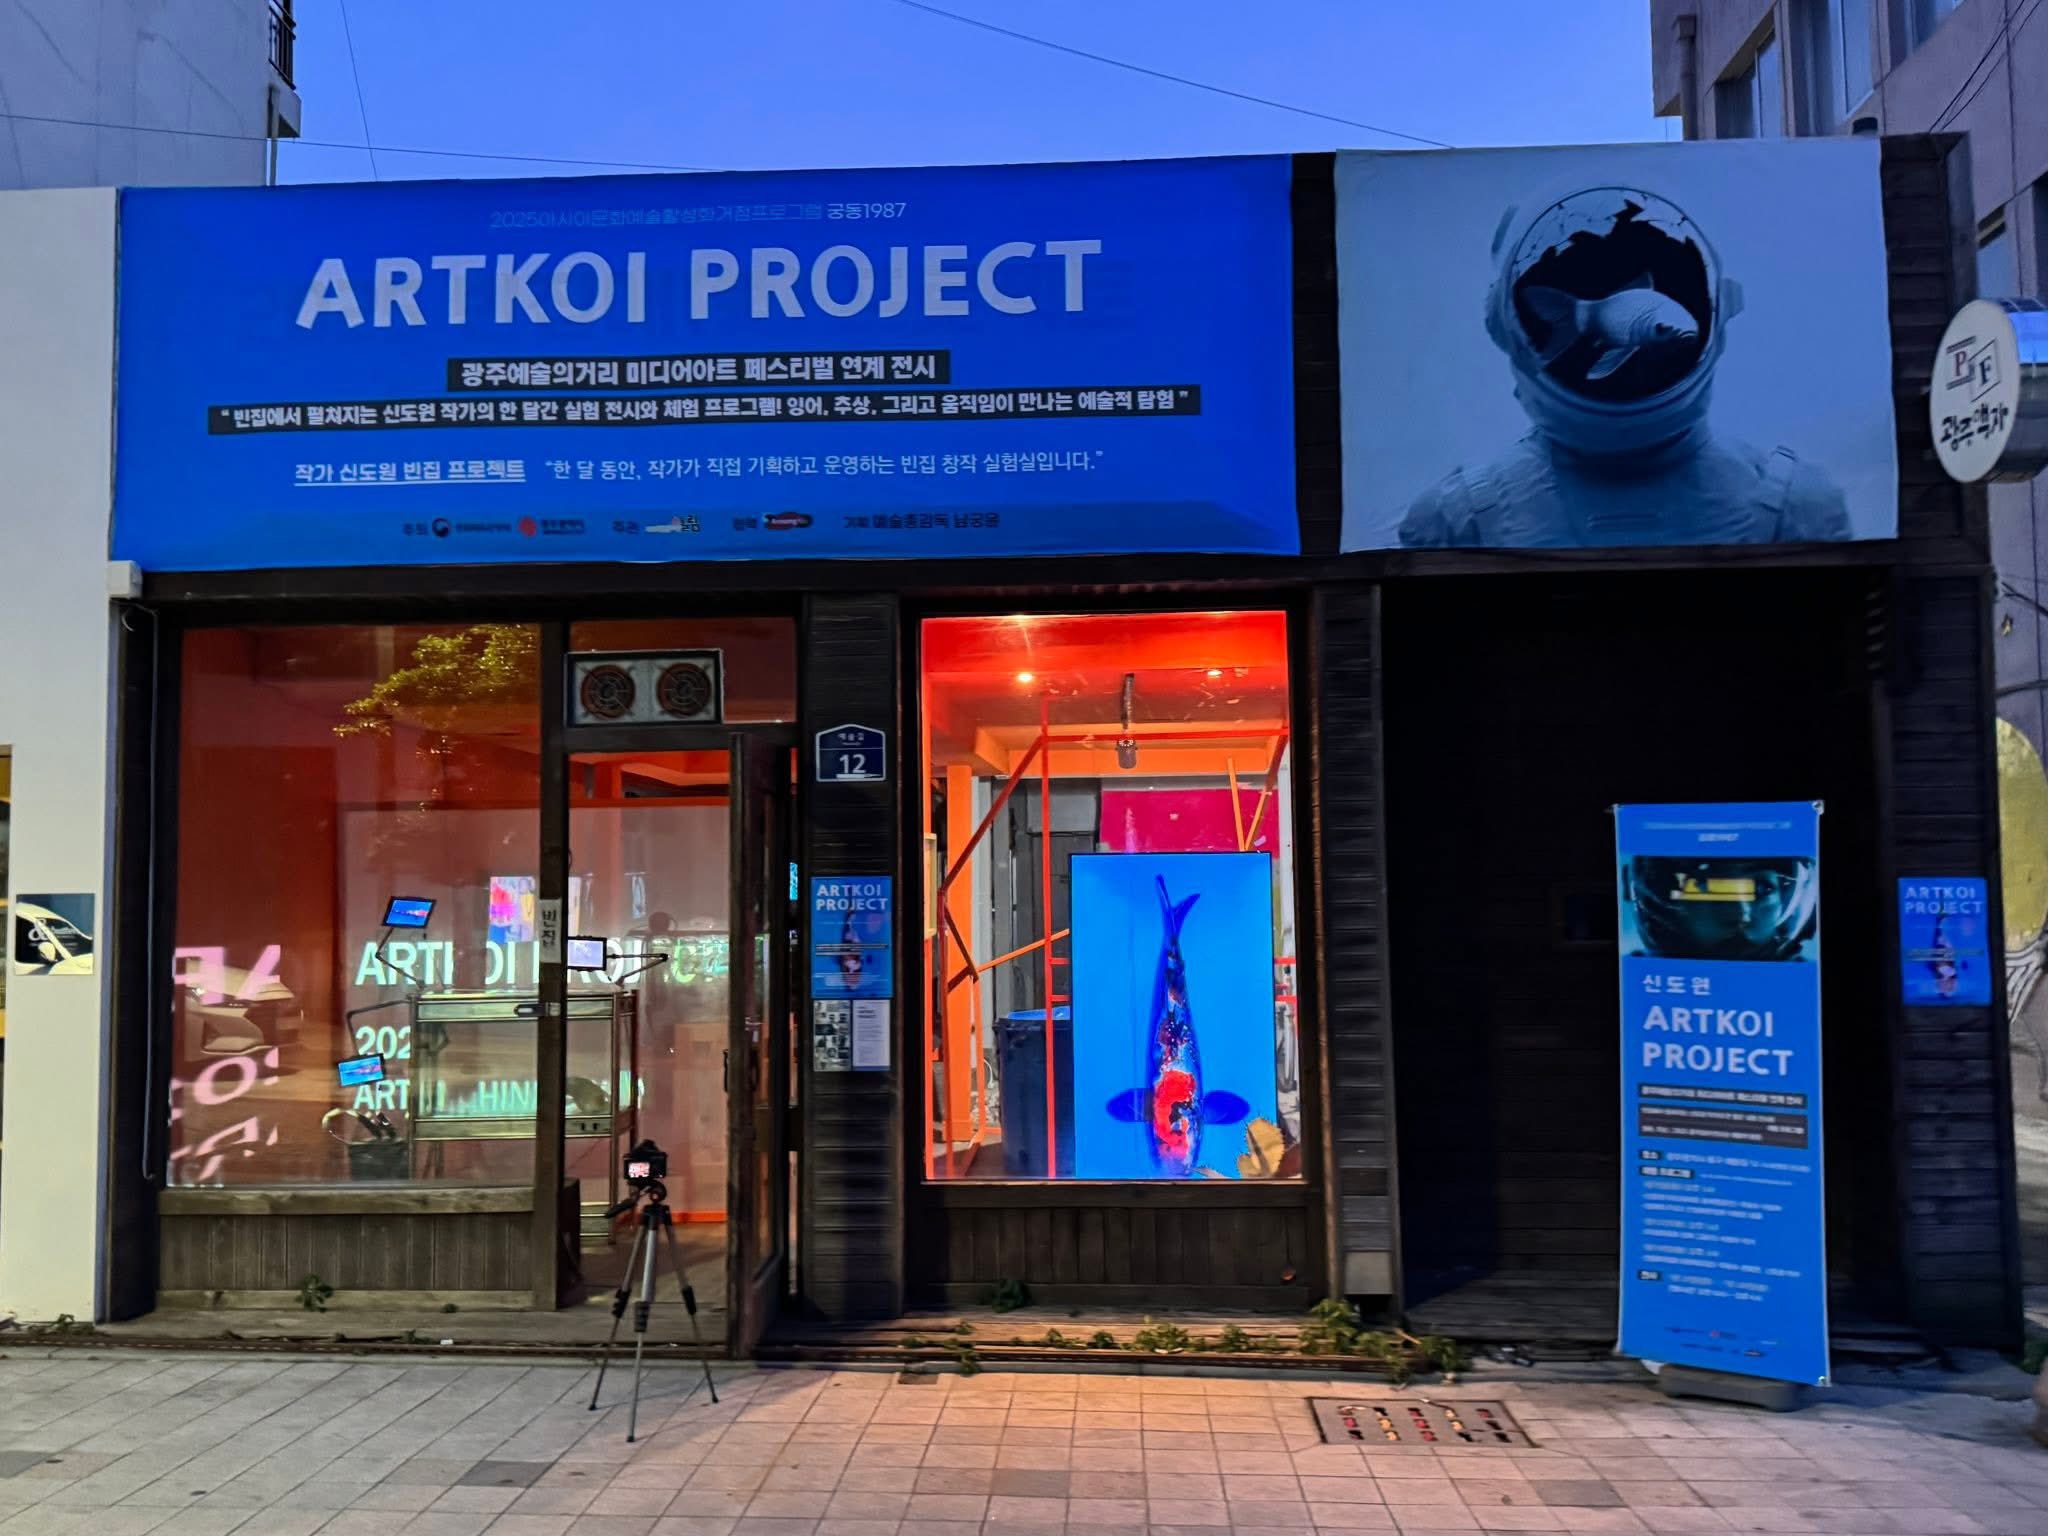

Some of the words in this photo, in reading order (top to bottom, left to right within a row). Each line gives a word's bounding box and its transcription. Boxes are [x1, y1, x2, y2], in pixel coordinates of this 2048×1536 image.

[827, 202, 907, 220] 궁동1987
[295, 251, 646, 330] ARTKOI
[690, 239, 1102, 320] PROJECT
[461, 361, 619, 387] 광주예술의거리
[626, 358, 738, 385] 미디어아트
[743, 356, 834, 382] 페스티벌
[840, 355, 885, 380] 연계
[891, 354, 936, 380] 전시
[382, 402, 436, 424] 신도원
[440, 401, 495, 422] 작가의
[498, 401, 518, 422] 한
[522, 401, 559, 421] 달간
[564, 400, 600, 421] 실험
[604, 399, 659, 421] 전시와
[663, 398, 700, 419] 체험
[786, 396, 829, 417] 잉어,
[833, 395, 877, 416] 추상,
[881, 395, 937, 415] 그리고
[940, 393, 1014, 415] 움직임이
[1018, 391, 1074, 412] 만나는
[1077, 390, 1132, 411] 예술적
[1137, 389, 1175, 410] 탐험
[295, 463, 335, 485] 작가
[339, 462, 397, 483] 신도원
[403, 461, 444, 483] 빈집
[447, 459, 526, 481] 프로젝트
[577, 460, 595, 480] 달
[599, 460, 641, 481] 동안,
[647, 458, 701, 479] 작가가
[707, 457, 741, 477] 직접
[748, 456, 819, 476] 기획하고
[823, 455, 896, 476] 운영하는
[901, 455, 936, 475] 빈집
[941, 454, 978, 475] 창작
[837, 753, 867, 774] 12
[816, 884, 881, 897] ARTKOI
[1905, 886, 1975, 899] ARTKOI
[815, 897, 888, 911] PROJECT
[1904, 900, 1983, 915] PROJECT
[1643, 1005, 1774, 1037] ARTKOI
[1643, 1041, 1793, 1076] PROJECT
